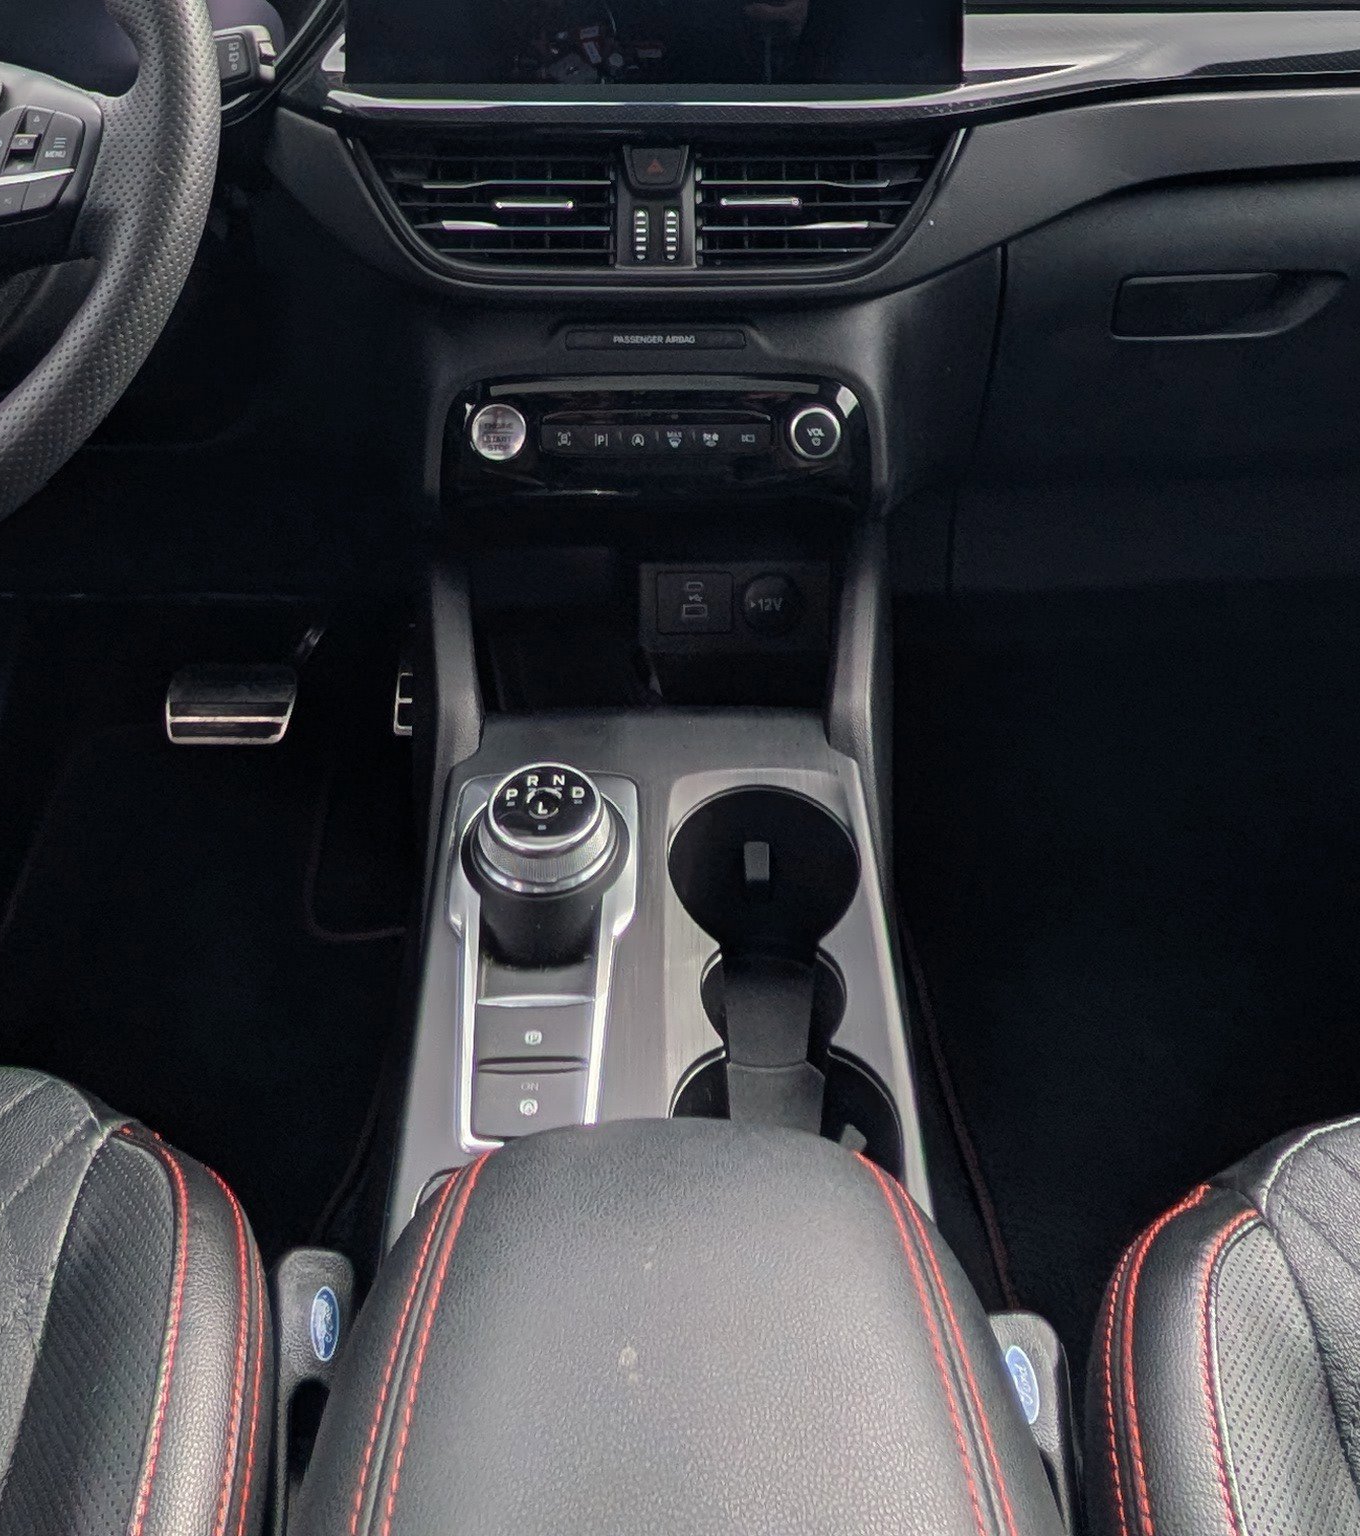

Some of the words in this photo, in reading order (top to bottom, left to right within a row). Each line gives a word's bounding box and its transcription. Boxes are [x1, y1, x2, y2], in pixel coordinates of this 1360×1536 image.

[613, 335, 664, 344] PASSENGER
[665, 335, 696, 344] AIRBAG
[758, 598, 783, 612] 12V
[505, 788, 519, 801] P
[527, 774, 540, 787] R
[553, 774, 566, 786] N
[572, 786, 586, 799] D
[538, 801, 549, 815] L
[521, 1082, 540, 1091] ON
